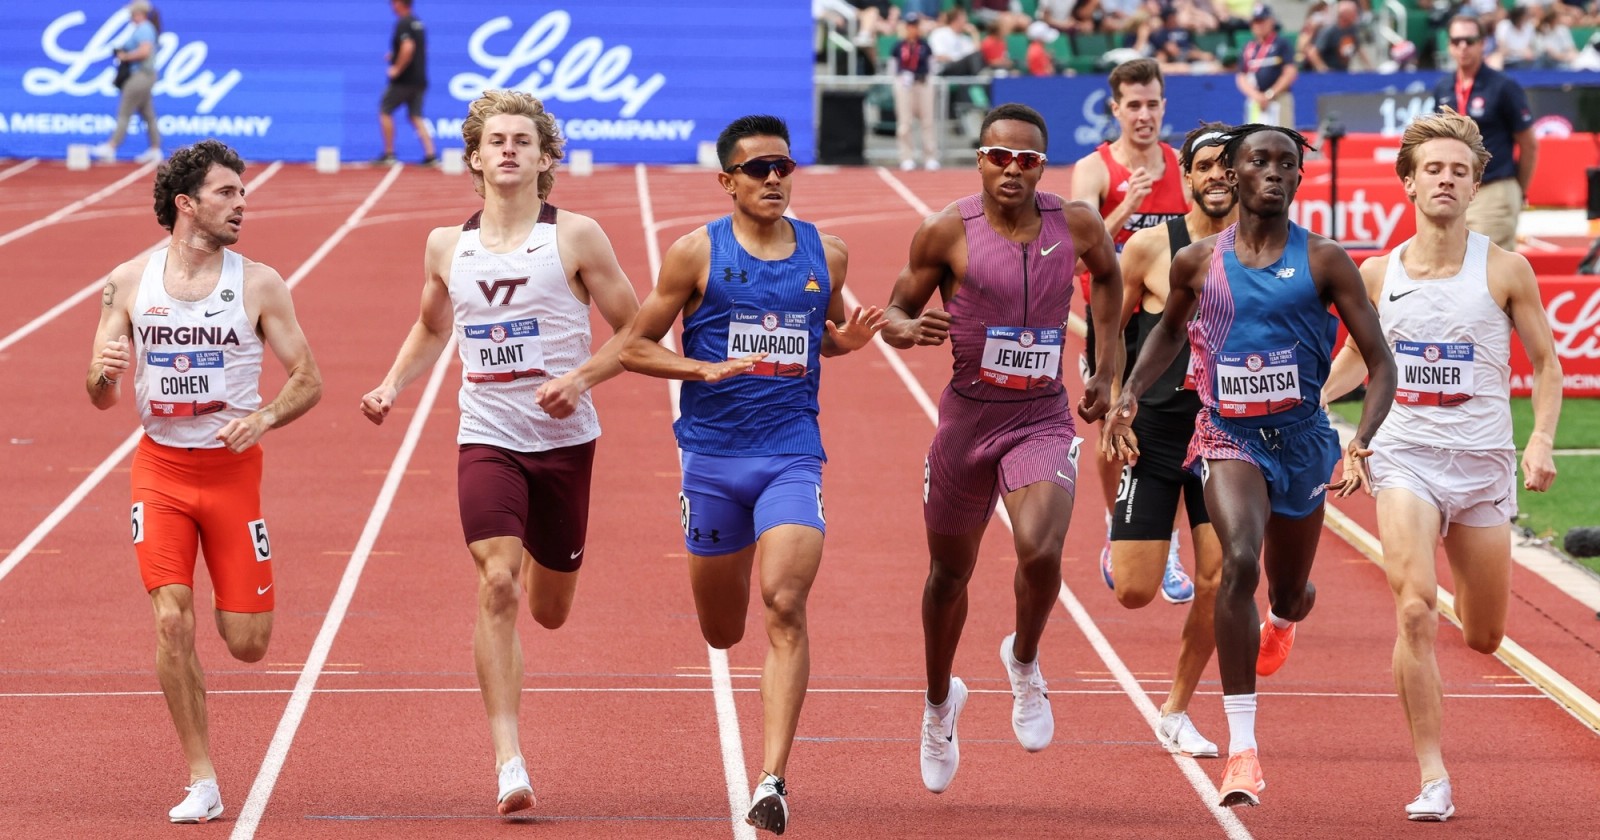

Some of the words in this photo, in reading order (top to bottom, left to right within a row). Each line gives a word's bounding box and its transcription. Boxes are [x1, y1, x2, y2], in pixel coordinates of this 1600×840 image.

[449, 10, 666, 118] Lilly
[564, 118, 696, 141] COMPANY
[475, 276, 531, 307] VT
[145, 306, 171, 316] ACC
[137, 325, 241, 347] VIRGINIA
[731, 333, 806, 355] ALVARADO
[480, 344, 525, 366] PLANT
[995, 348, 1051, 369] JEWETT
[160, 375, 209, 395] COHEN
[1221, 371, 1296, 395] MATSATSA
[1405, 365, 1461, 385] WISNER
[254, 522, 270, 558] 5
